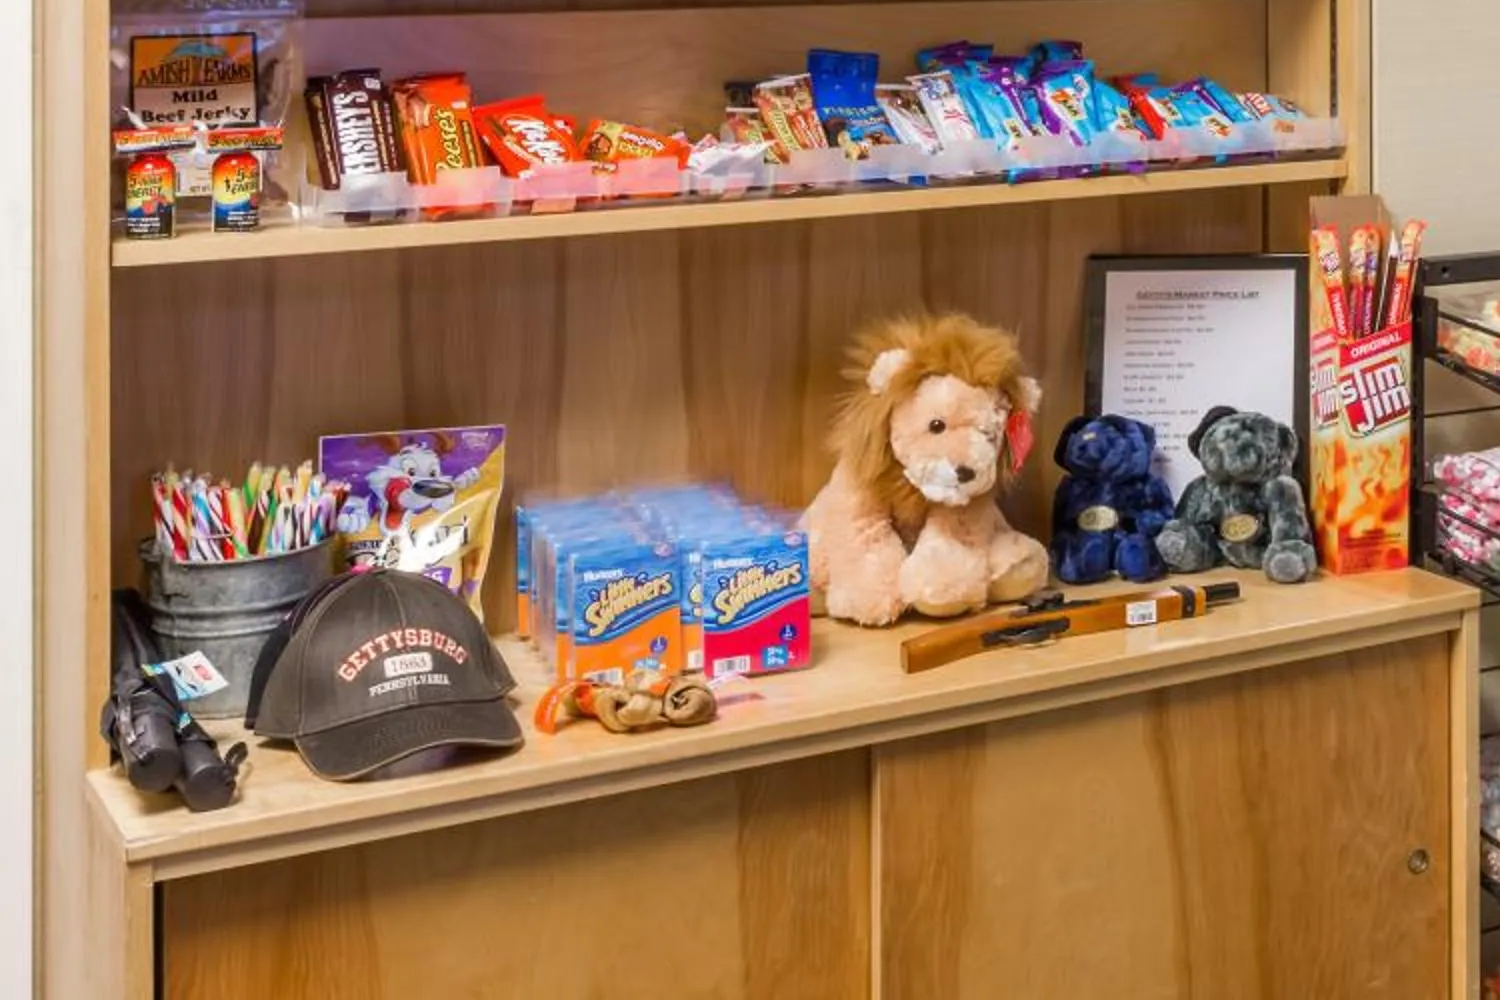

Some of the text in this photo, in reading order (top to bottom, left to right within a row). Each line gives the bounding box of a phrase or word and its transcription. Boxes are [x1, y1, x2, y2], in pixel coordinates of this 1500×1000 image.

[138, 55, 191, 85] AMISH
[172, 88, 218, 103] Mild
[141, 109, 186, 123] Beef
[333, 90, 382, 175] ERSHEY'S
[1349, 332, 1402, 359] ORIGINAL
[585, 573, 673, 637] Swimmers
[714, 562, 803, 625] Swimmers
[337, 627, 469, 682] GETTYSBURG
[368, 672, 451, 697] PENNSYLVANIA
